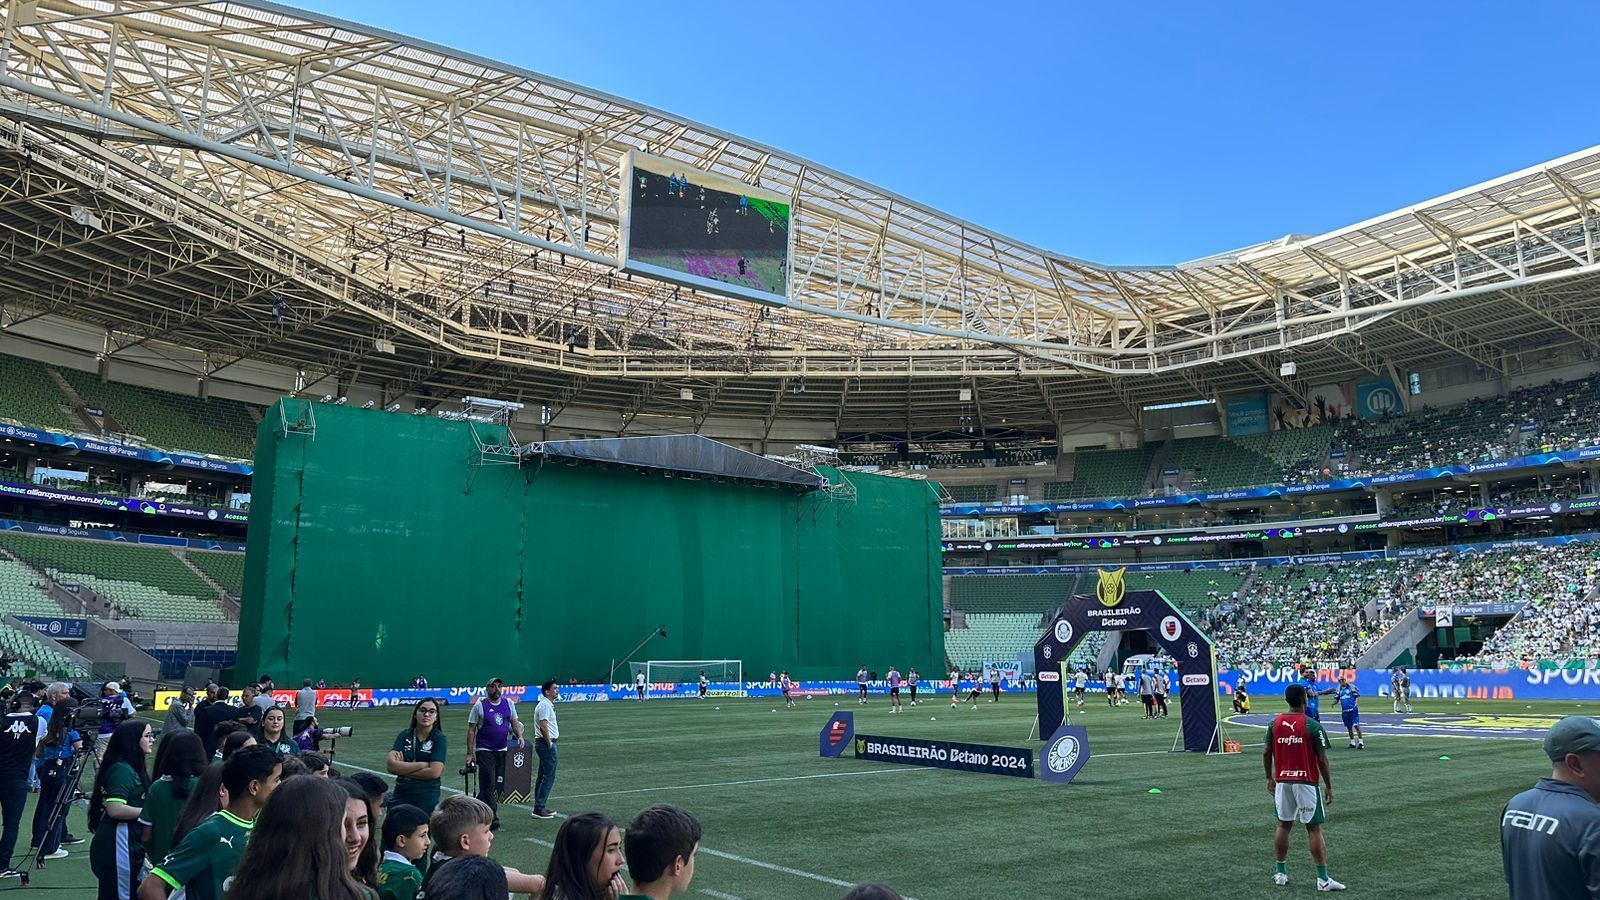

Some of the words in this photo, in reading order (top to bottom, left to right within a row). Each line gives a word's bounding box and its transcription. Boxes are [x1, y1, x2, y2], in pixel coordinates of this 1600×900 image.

[85, 441, 108, 452] Allianz
[117, 447, 138, 457] Parque
[181, 457, 200, 467] Allianz
[208, 462, 228, 470] Seguros
[1312, 483, 1331, 491] Parque
[224, 513, 249, 521] Acesse:
[38, 524, 59, 533] Allianz
[68, 528, 89, 536] Seguros
[1087, 606, 1142, 617] BRASILEIRÃO
[1461, 606, 1484, 614] Parque
[1101, 618, 1128, 627] Betano
[1184, 676, 1207, 684] Betano
[1277, 734, 1303, 746] crefisa
[866, 742, 948, 762] BRASILEIRÃO
[949, 748, 989, 766] Betano
[991, 754, 1027, 770] 2024
